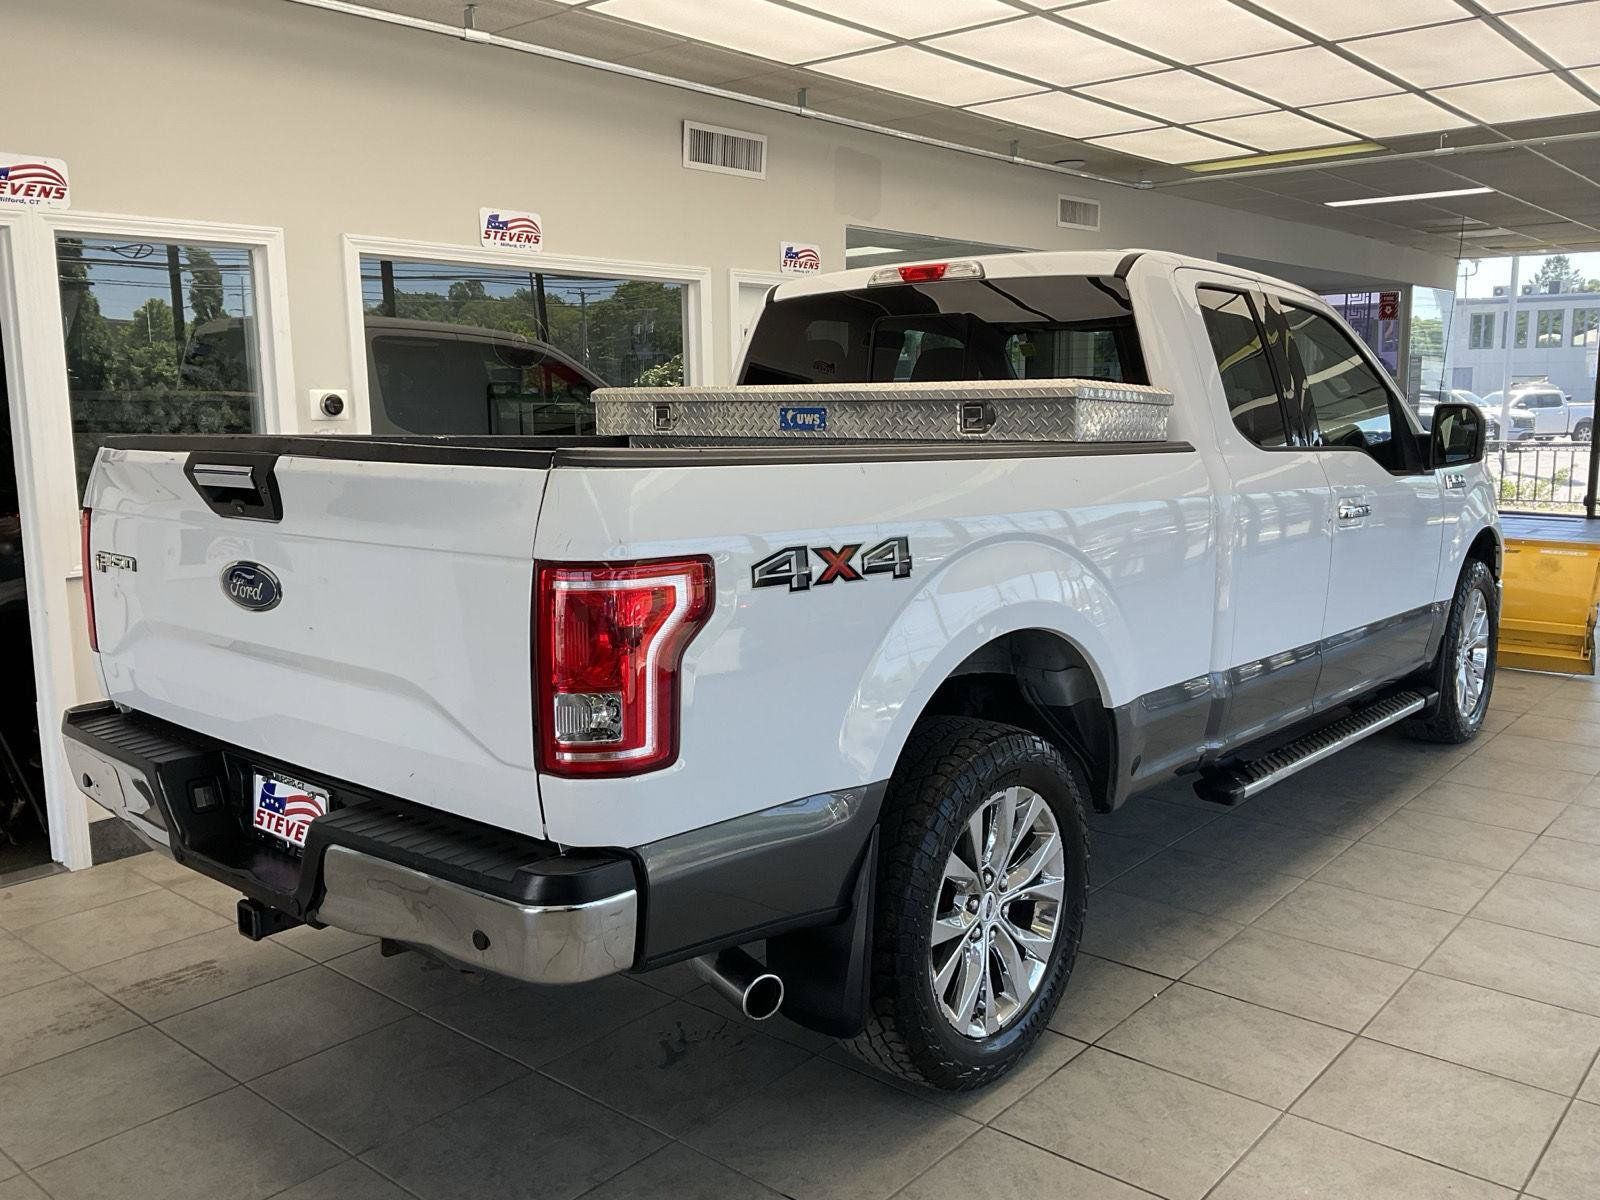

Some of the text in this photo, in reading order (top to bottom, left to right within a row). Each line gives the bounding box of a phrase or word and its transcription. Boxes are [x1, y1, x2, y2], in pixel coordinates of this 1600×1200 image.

[0, 181, 67, 200] EVENS
[483, 229, 541, 245] STEVENS
[783, 259, 820, 270] STEVENS
[796, 413, 820, 425] UWS
[229, 571, 263, 600] Ford
[255, 808, 306, 843] STEVE
